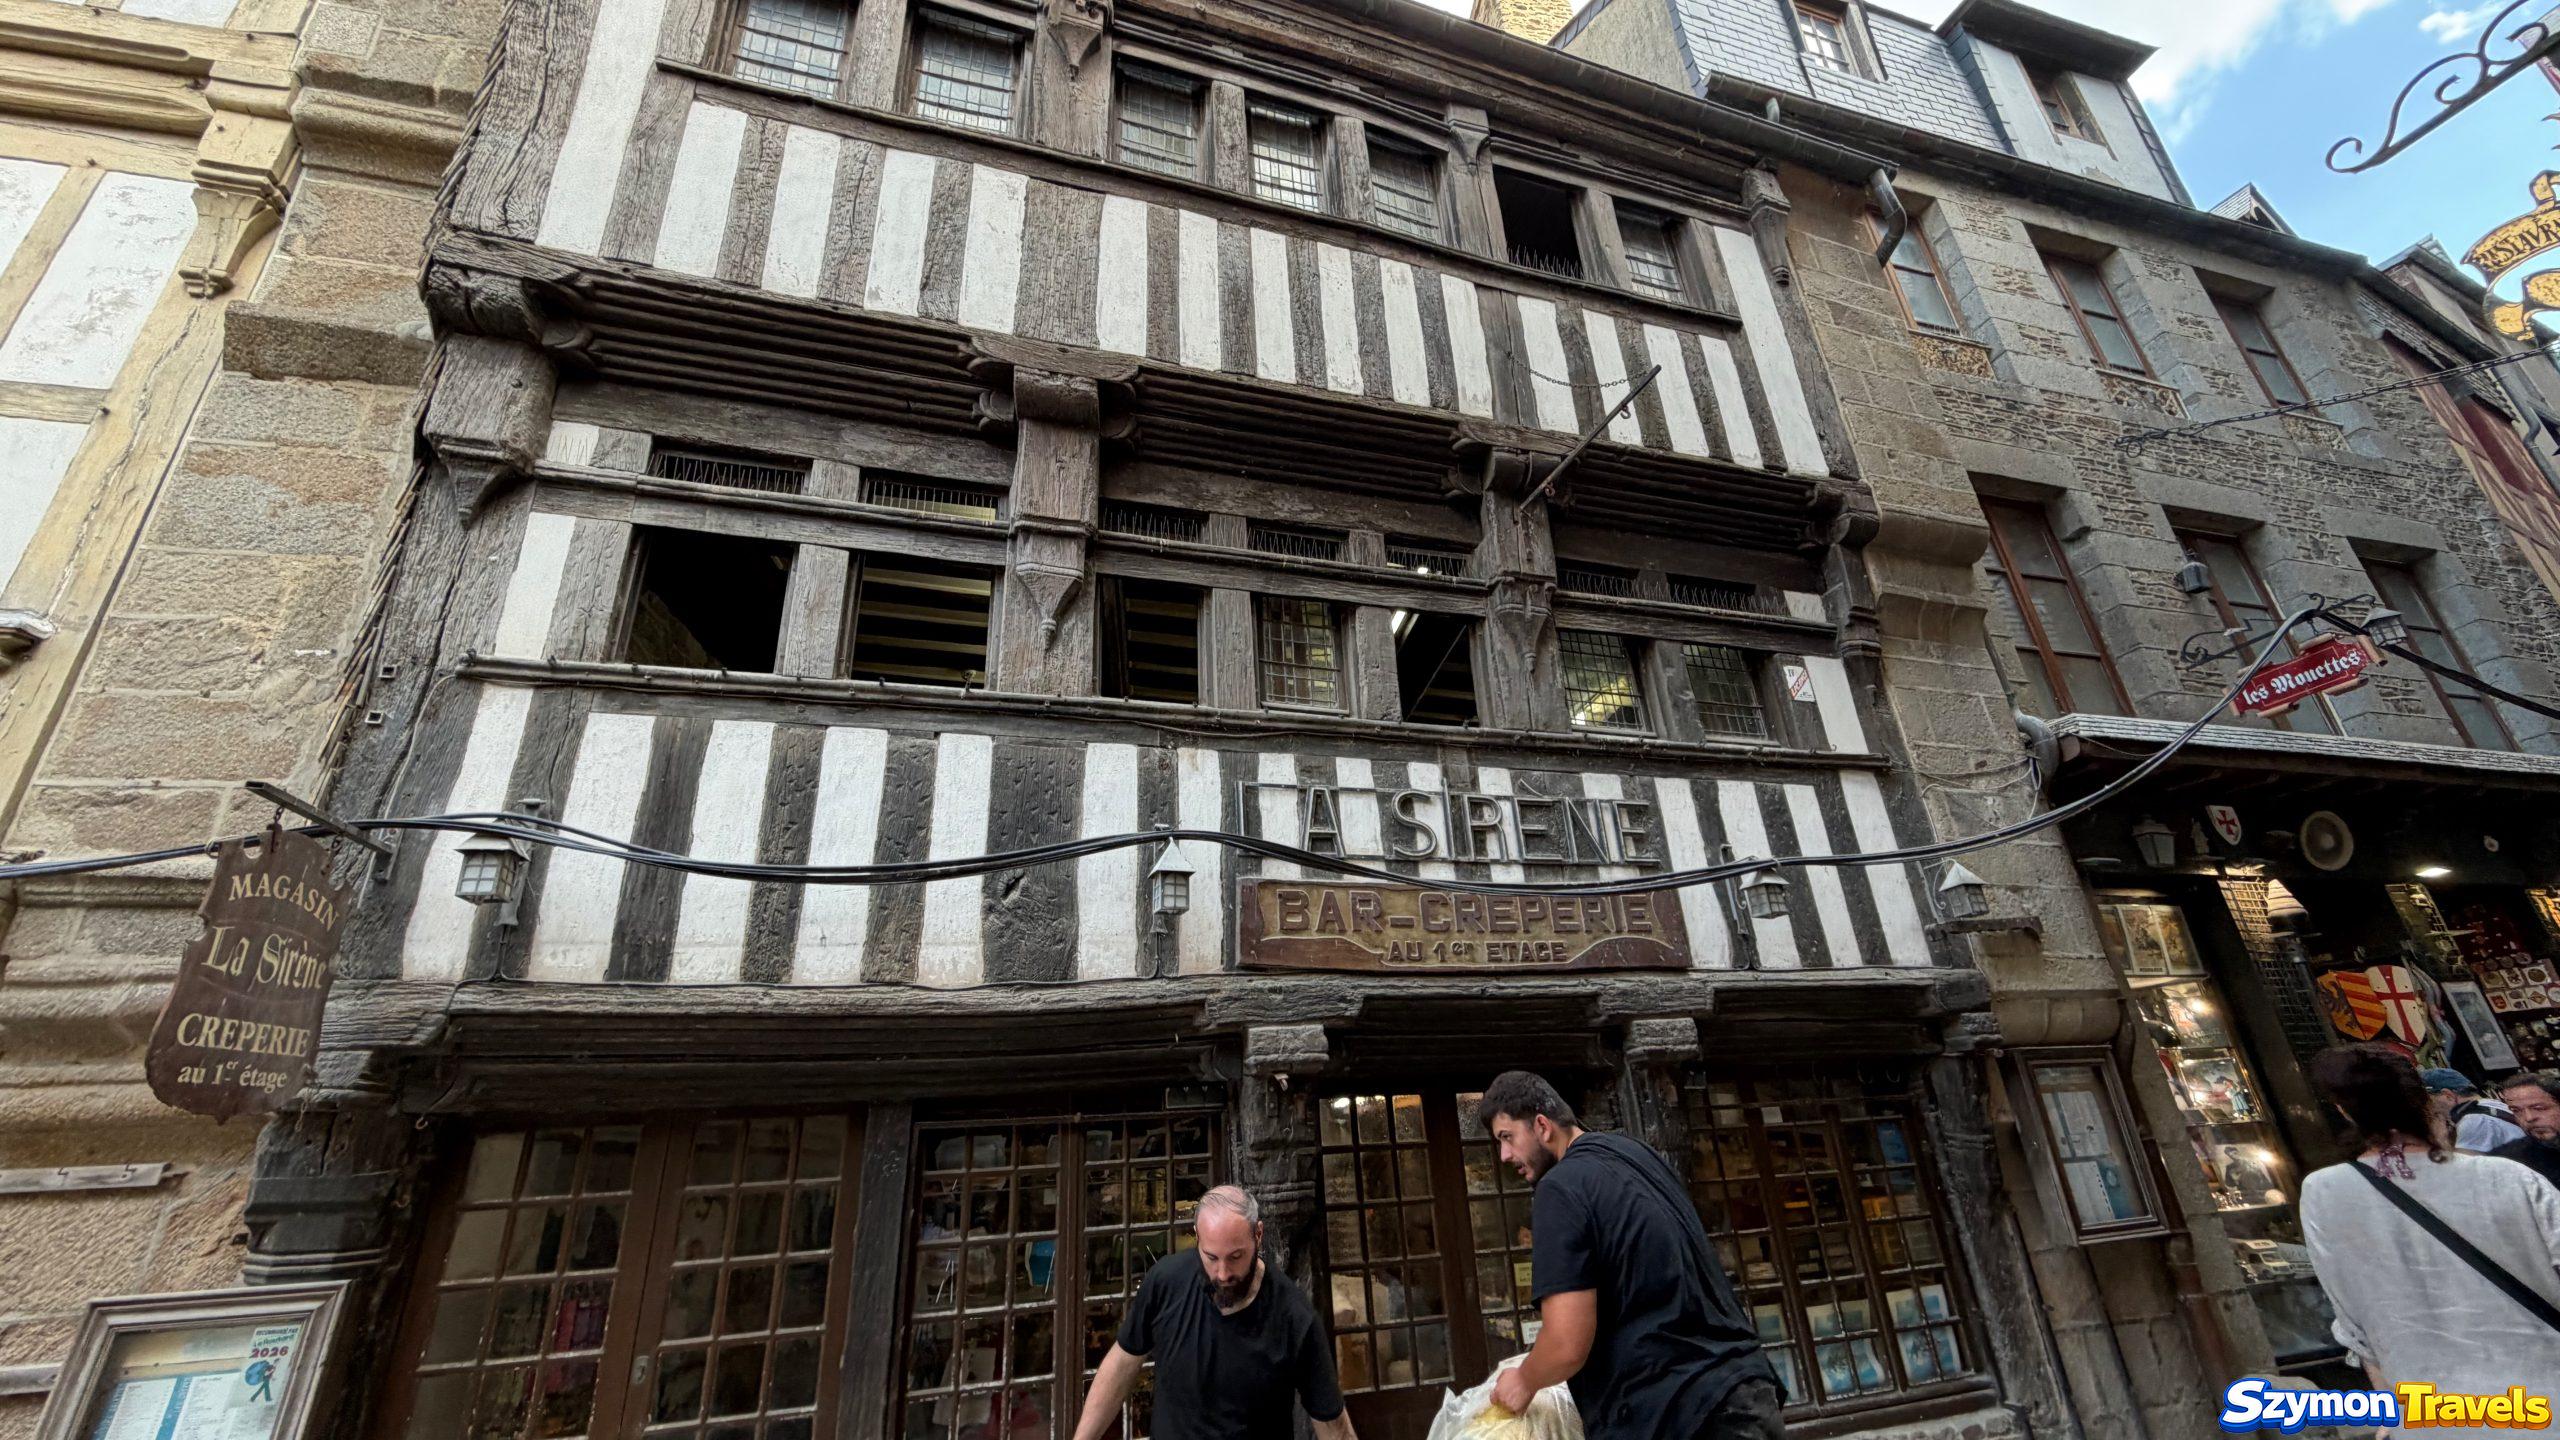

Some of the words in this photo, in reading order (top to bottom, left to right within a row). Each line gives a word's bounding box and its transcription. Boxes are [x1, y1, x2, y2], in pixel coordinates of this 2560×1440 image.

[2242, 684, 2269, 705] les
[2270, 649, 2360, 694] Mouettes
[1235, 781, 1346, 859] LA
[1391, 777, 1661, 865] SIRÈNE
[228, 873, 340, 932] MAGASIN
[202, 926, 250, 976] La
[255, 933, 328, 989] Sirène
[1387, 940, 1423, 963] AU
[1484, 941, 1568, 963] ETAGE
[176, 1012, 311, 1058] CREPERIE
[177, 1065, 205, 1084] au
[211, 1060, 239, 1085] 1er
[239, 1064, 288, 1094] étage
[249, 1346, 289, 1359] 2026
